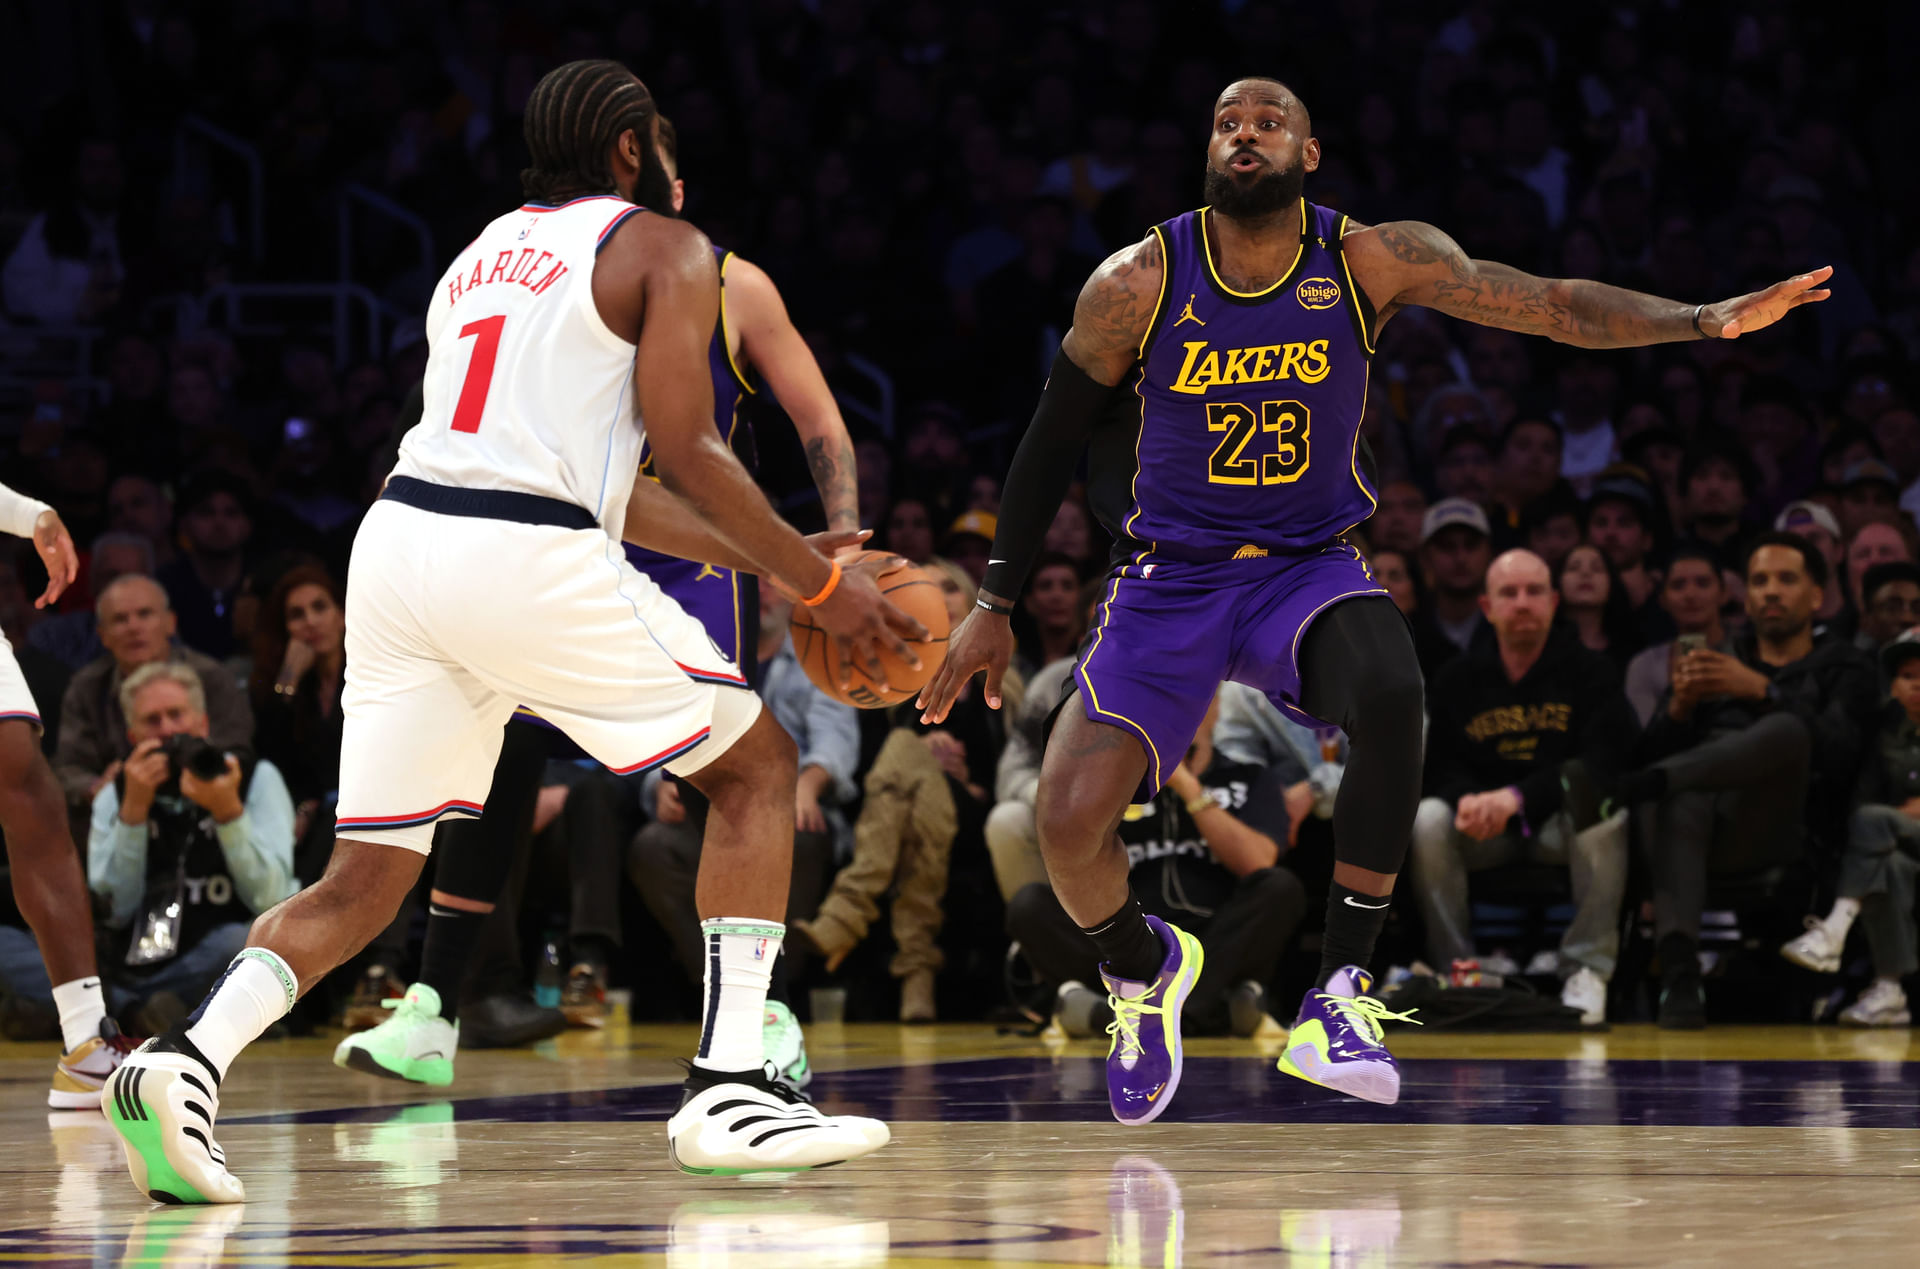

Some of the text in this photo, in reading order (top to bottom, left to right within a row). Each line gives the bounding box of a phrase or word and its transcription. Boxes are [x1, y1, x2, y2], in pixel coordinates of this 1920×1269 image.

[448, 248, 568, 307] HARDEN
[1300, 286, 1338, 300] bibigo
[450, 315, 507, 434] 1
[1169, 339, 1331, 395] LAKERS
[1206, 400, 1311, 486] 23
